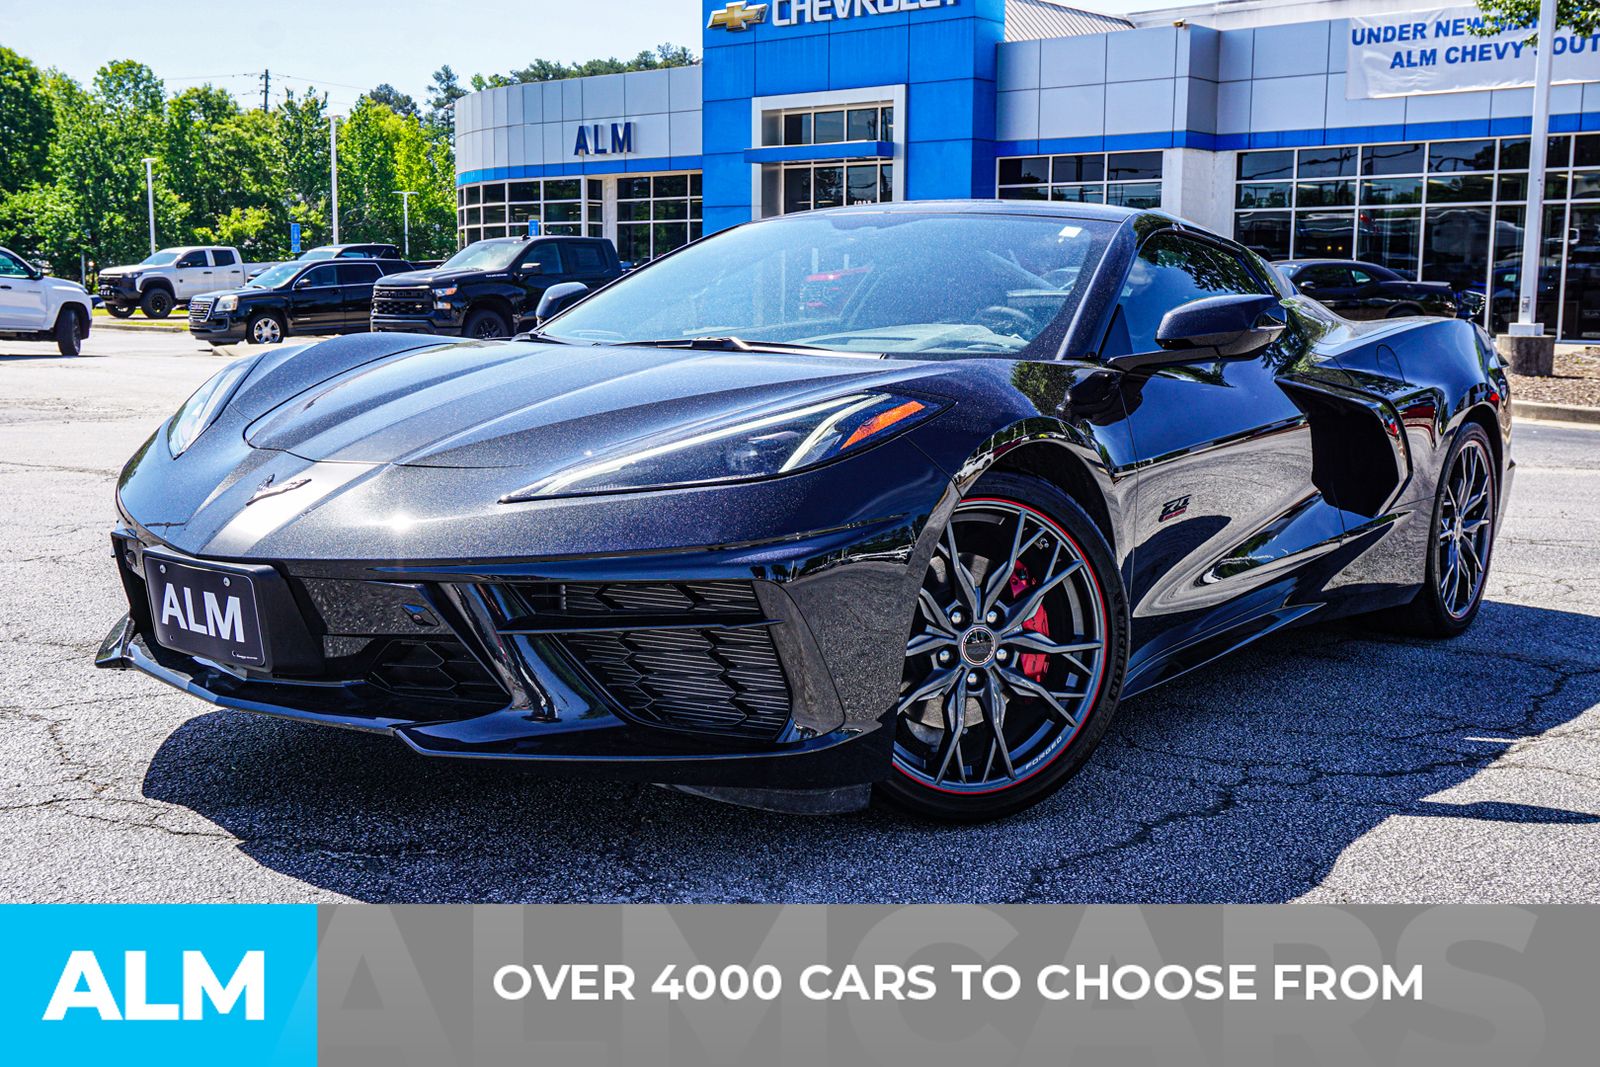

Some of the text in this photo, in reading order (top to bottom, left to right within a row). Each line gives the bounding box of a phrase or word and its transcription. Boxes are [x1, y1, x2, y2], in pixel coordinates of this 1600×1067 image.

[772, 0, 955, 26] CHEVR
[1352, 22, 1427, 46] UNDER
[1390, 34, 1600, 69] ALM CHEVY OUT
[574, 122, 633, 155] ALM
[162, 582, 245, 643] ALM
[1025, 735, 1062, 770] FORGED
